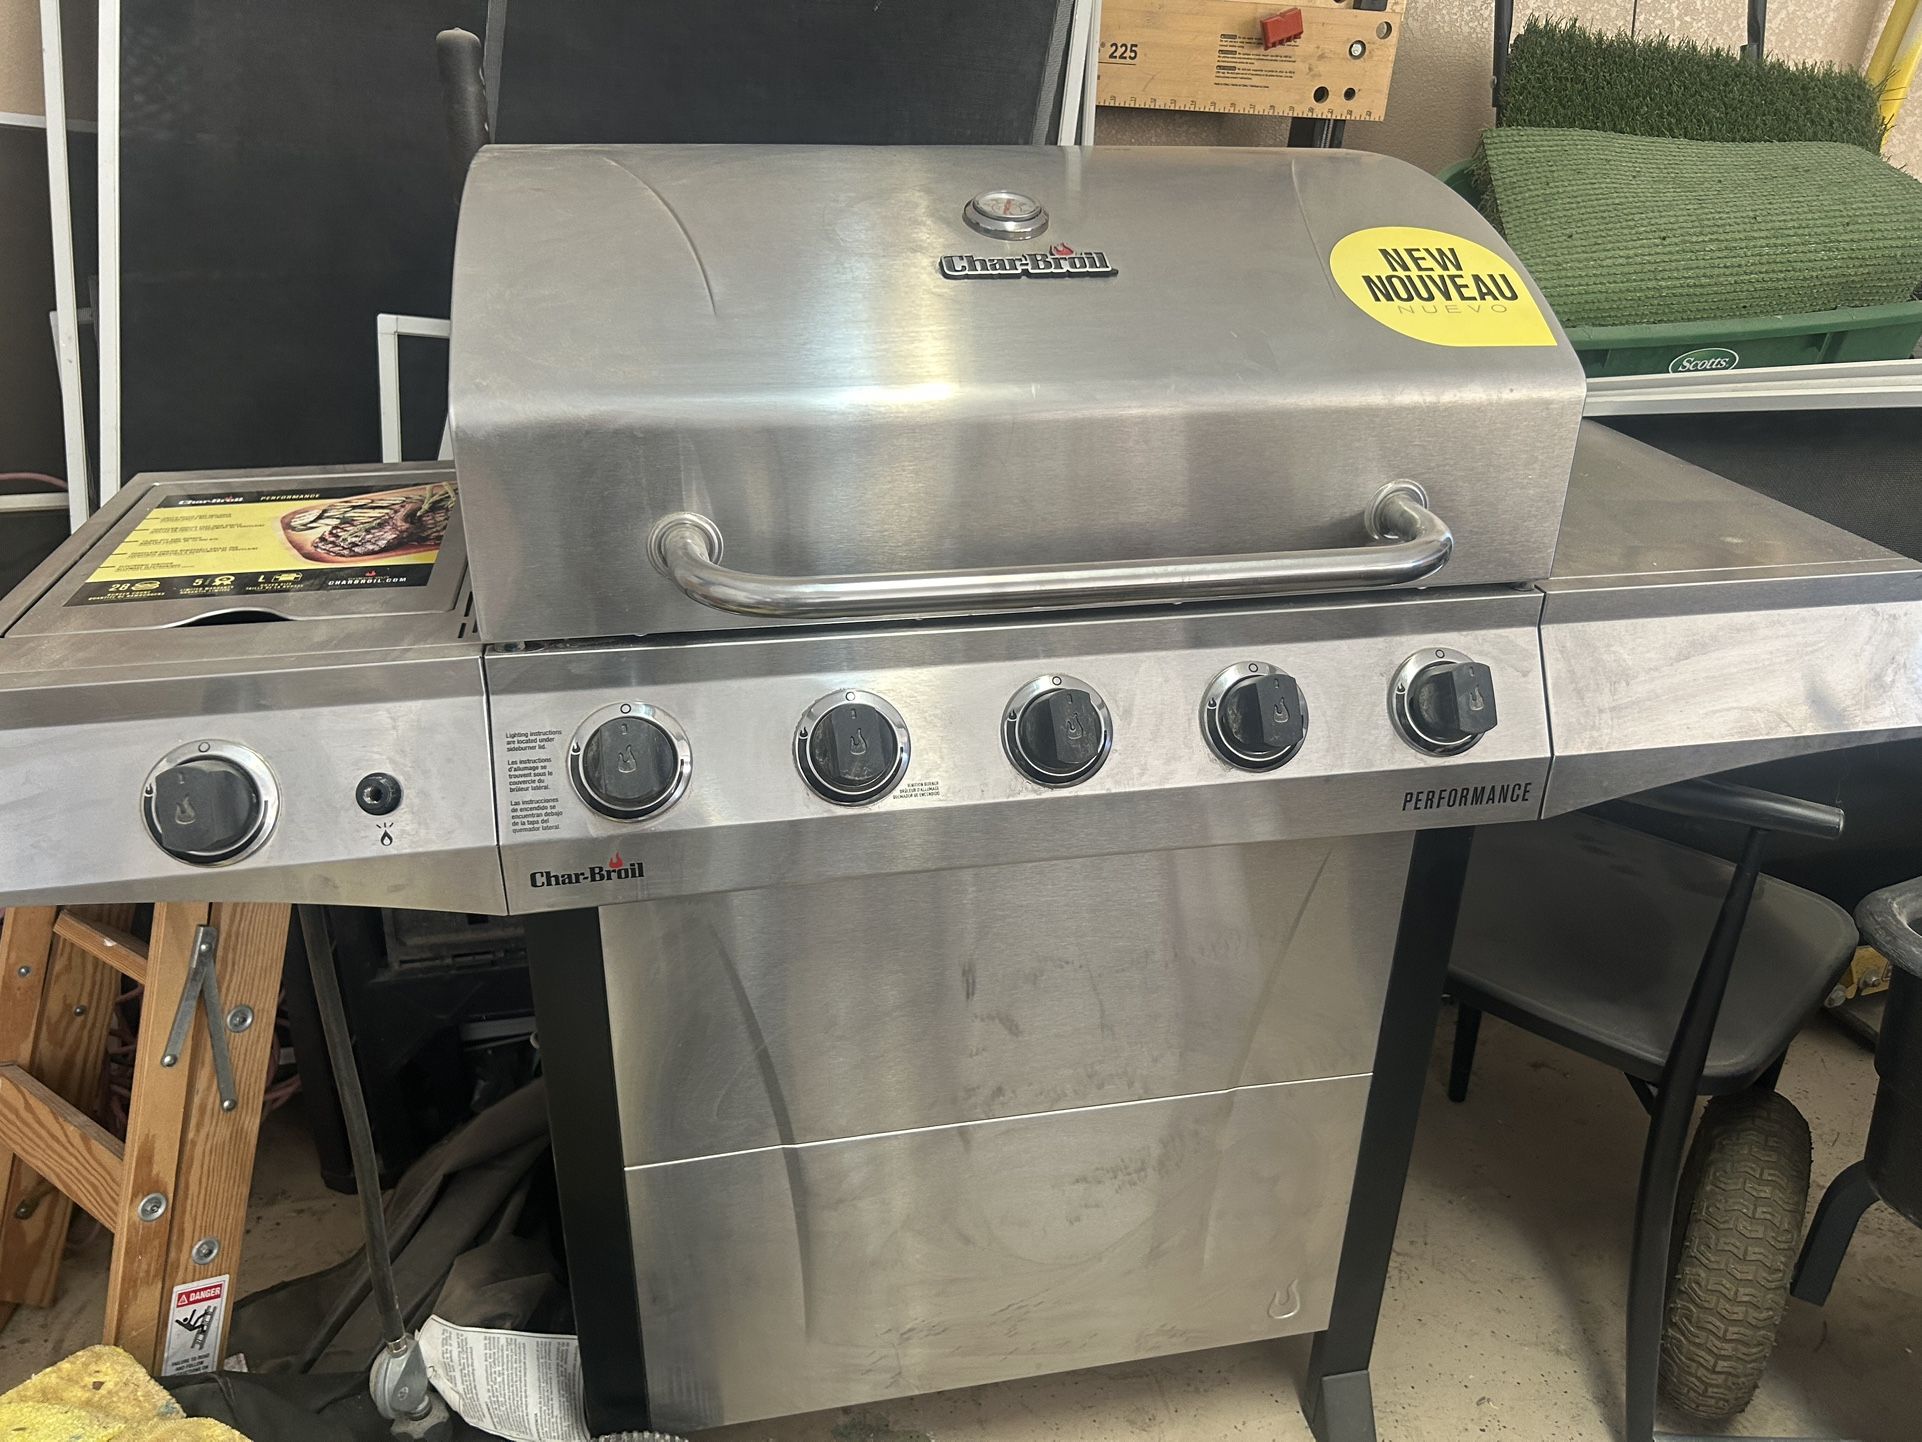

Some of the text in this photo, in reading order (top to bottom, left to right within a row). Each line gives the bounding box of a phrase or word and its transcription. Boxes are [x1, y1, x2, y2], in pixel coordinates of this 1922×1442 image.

[1109, 43, 1138, 60] 225
[940, 252, 1112, 277] Char-Broil
[1378, 248, 1463, 272] NEW
[1362, 274, 1519, 302] NOUVEAU
[1398, 304, 1508, 314] NUEVO
[1678, 357, 1730, 371] Scotts
[108, 583, 130, 591] 28
[193, 578, 203, 586] 5
[328, 577, 407, 586] CHARBROIL.COM
[529, 729, 562, 737] instructions
[1402, 782, 1532, 811] PERFORMANCE
[511, 812, 543, 820] encuentran
[530, 862, 644, 888] Char-Broil
[189, 1287, 221, 1302] DANGER
